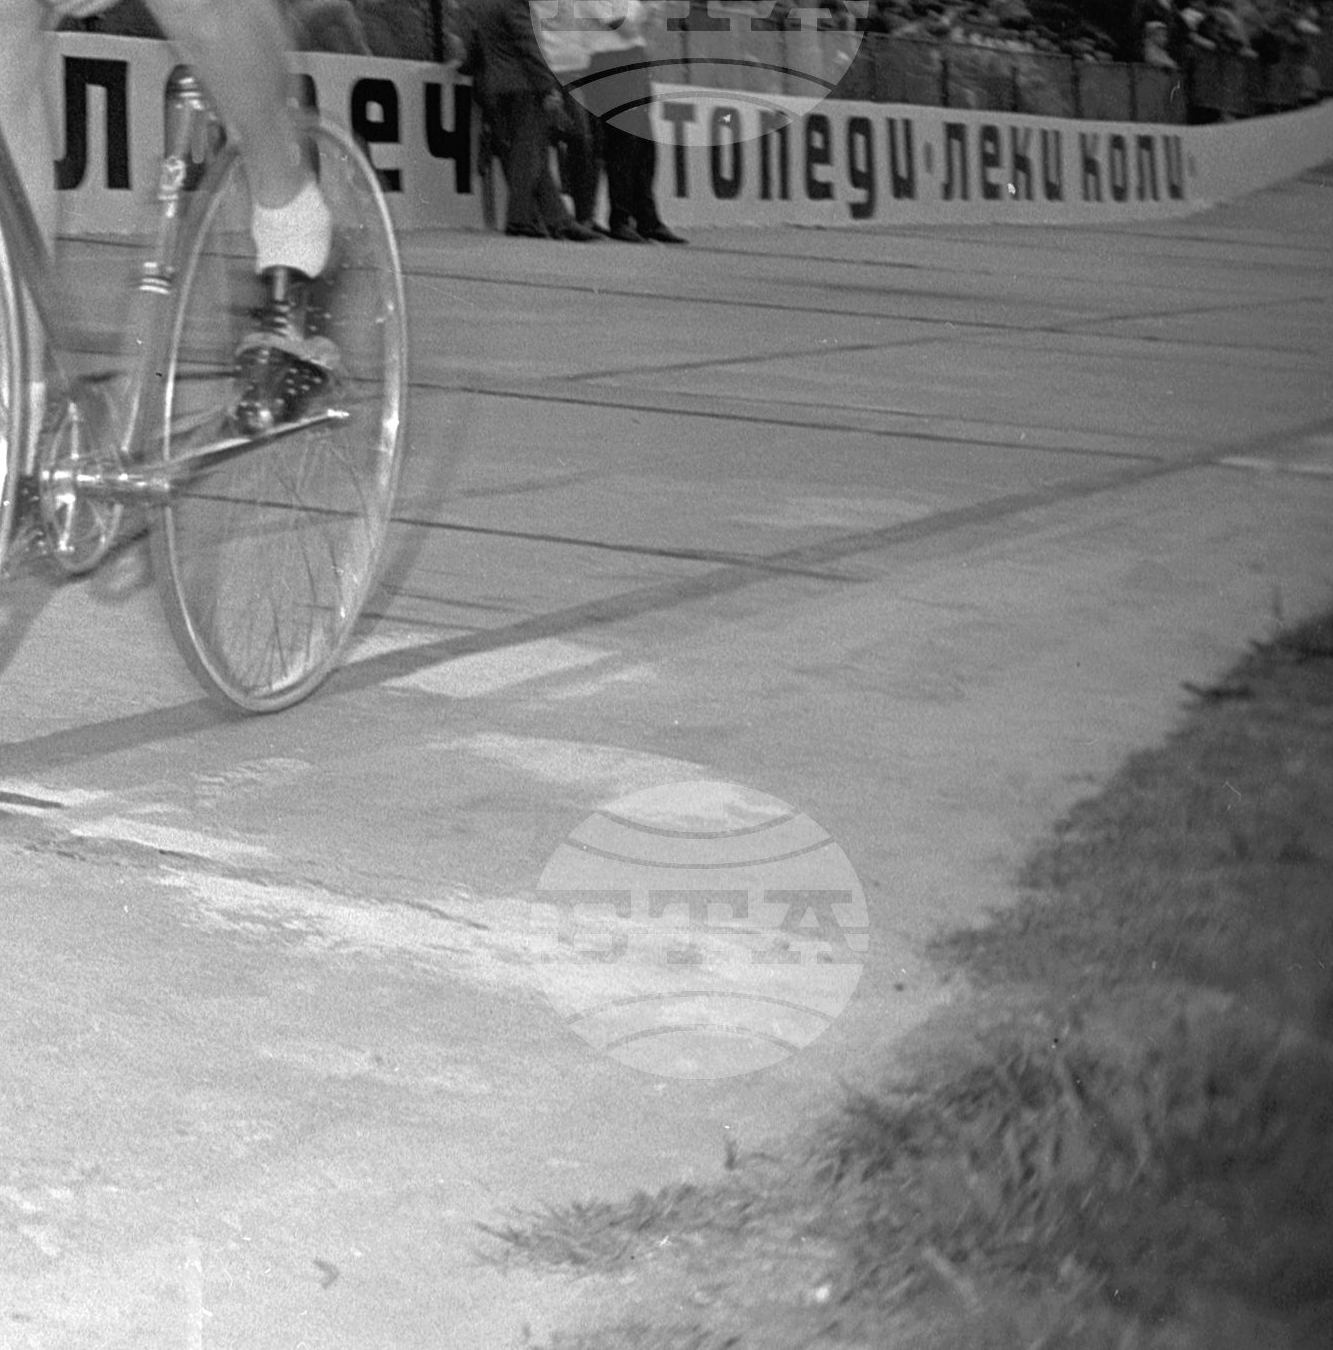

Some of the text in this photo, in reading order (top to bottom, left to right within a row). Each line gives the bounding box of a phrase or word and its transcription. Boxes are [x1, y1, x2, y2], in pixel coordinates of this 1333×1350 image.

[662, 102, 917, 220] топеди
[941, 121, 1063, 200] леки
[1079, 132, 1182, 202] коли
